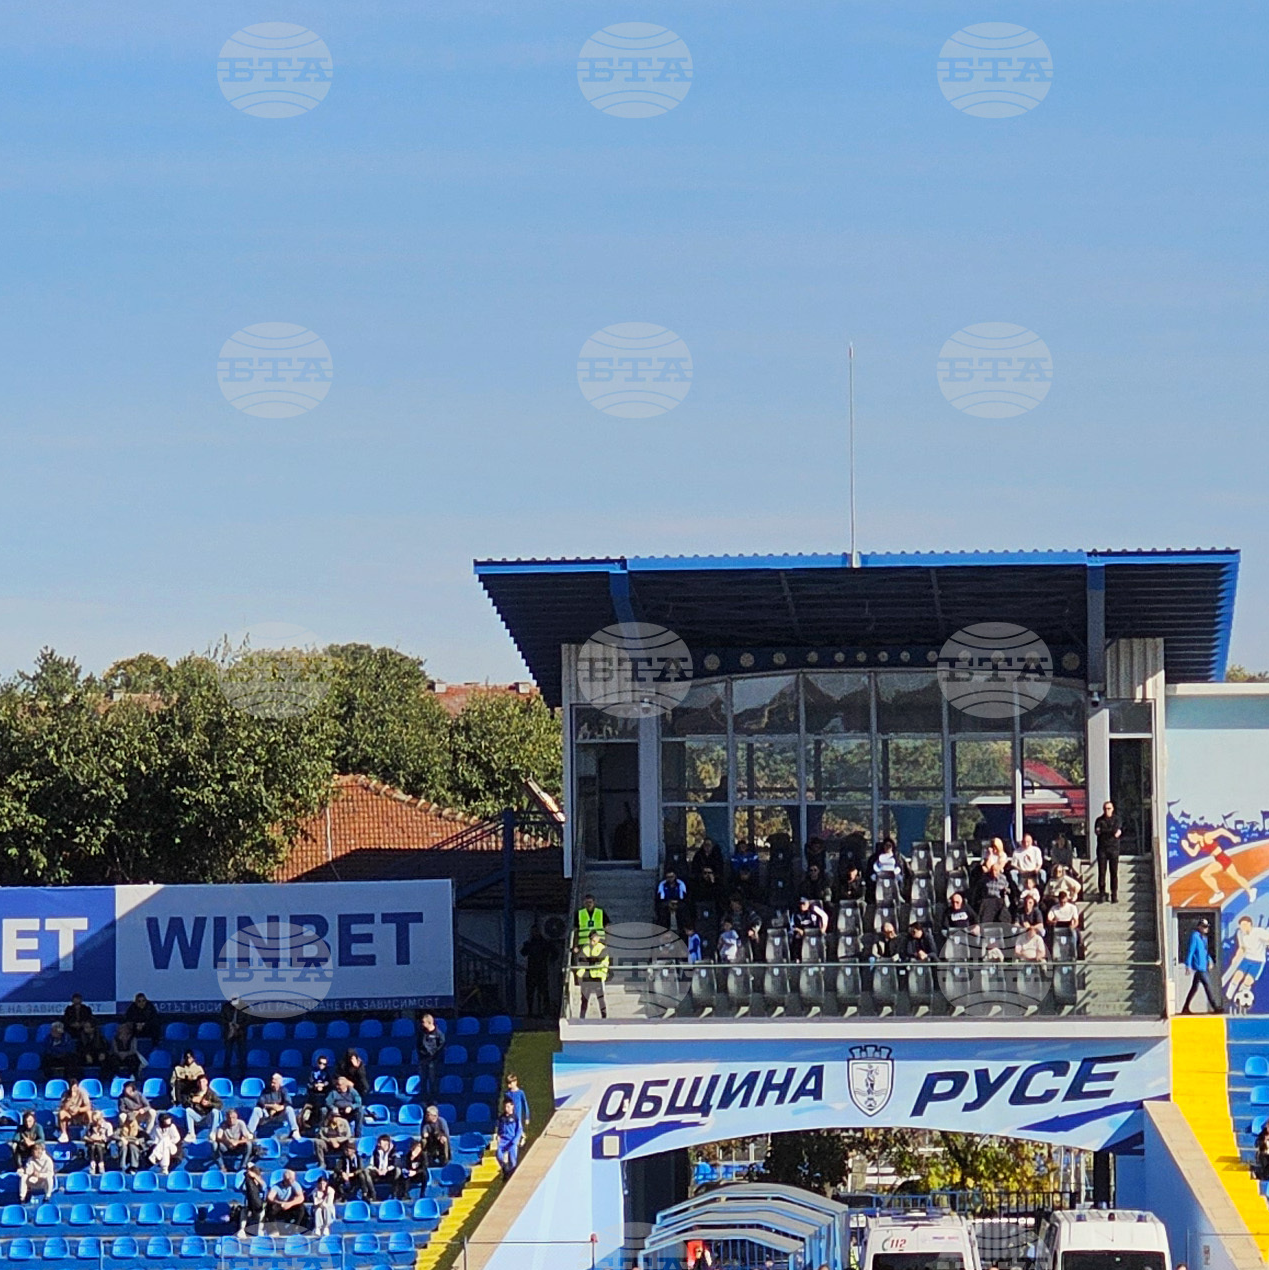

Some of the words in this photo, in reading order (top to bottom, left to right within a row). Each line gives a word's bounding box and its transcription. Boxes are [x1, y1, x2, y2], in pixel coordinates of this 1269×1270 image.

[146, 912, 423, 970] WINBET
[597, 1064, 825, 1122] ОБЩИНА
[911, 1053, 1137, 1118] РУСЕ
